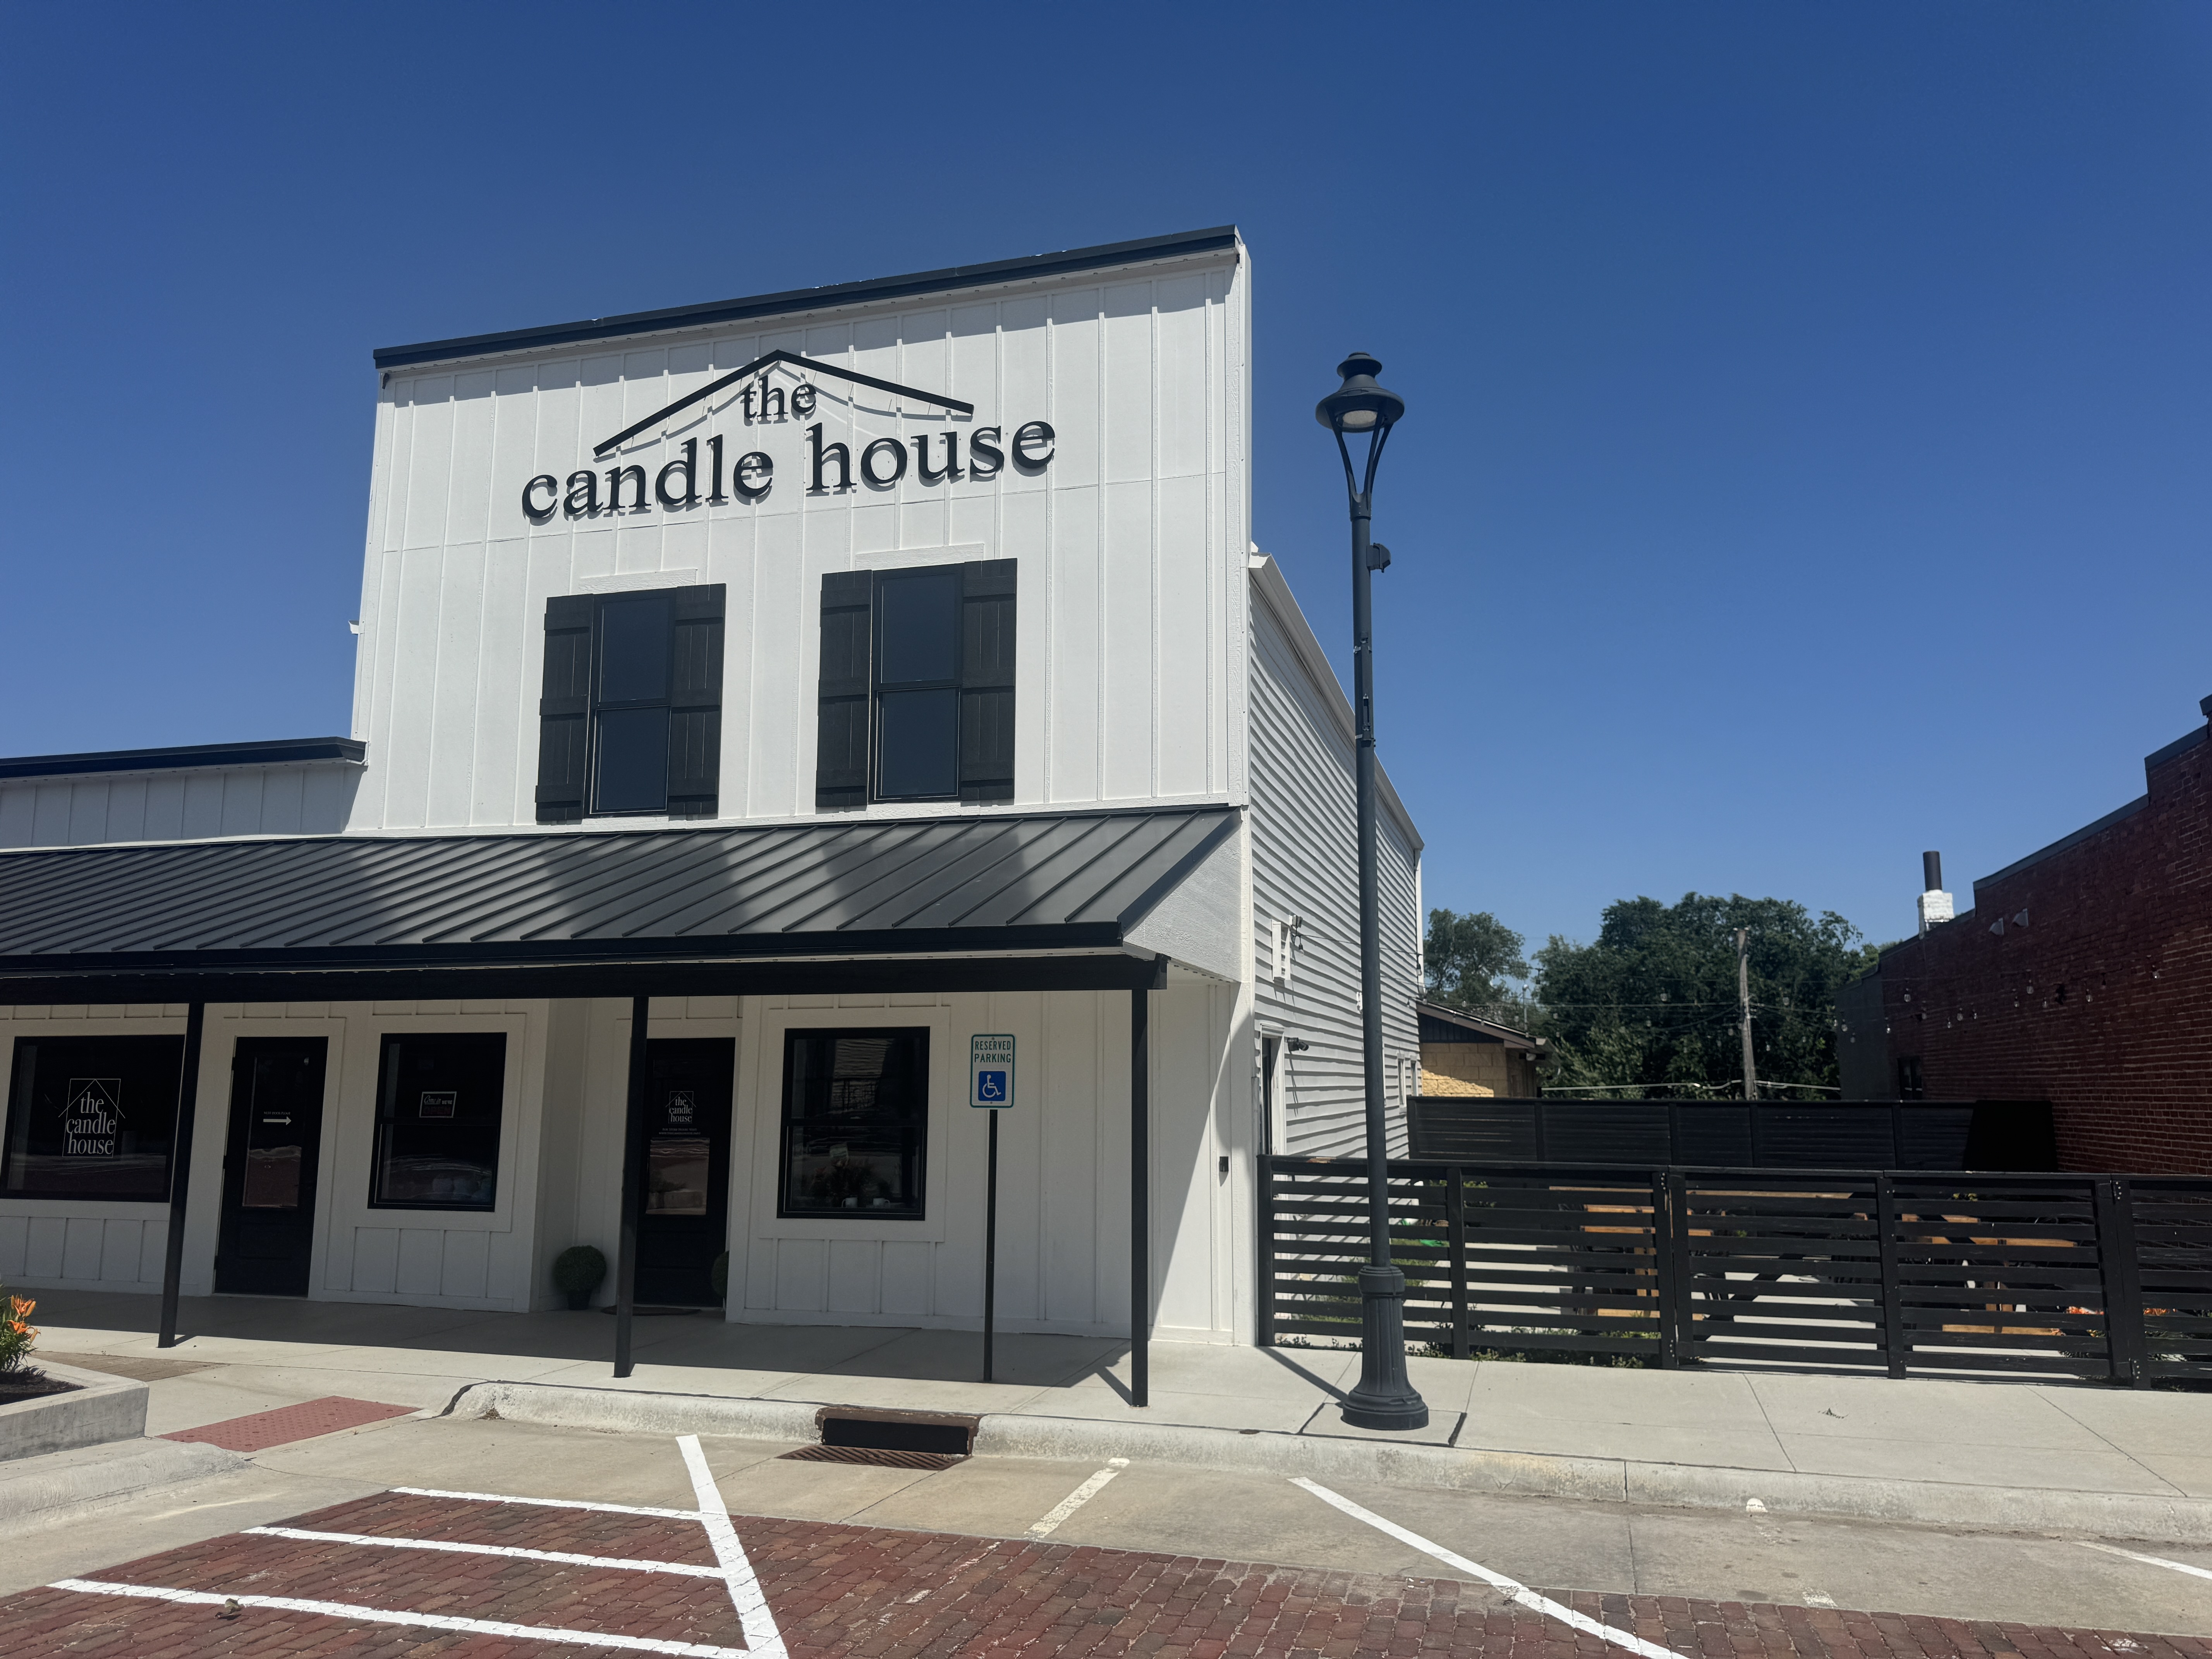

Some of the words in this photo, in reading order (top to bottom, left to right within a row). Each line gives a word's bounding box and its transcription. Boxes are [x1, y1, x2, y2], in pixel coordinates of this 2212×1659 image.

[740, 375, 817, 421] the
[522, 434, 773, 519] candle
[806, 421, 1056, 493] house
[975, 1041, 1011, 1050] RESERVED
[974, 1053, 1011, 1063] PARKING
[80, 1091, 104, 1114] the
[669, 1104, 692, 1114] candle
[675, 1096, 687, 1106] the
[66, 1111, 116, 1134] candle
[670, 1113, 692, 1122] house
[67, 1132, 114, 1155] house
